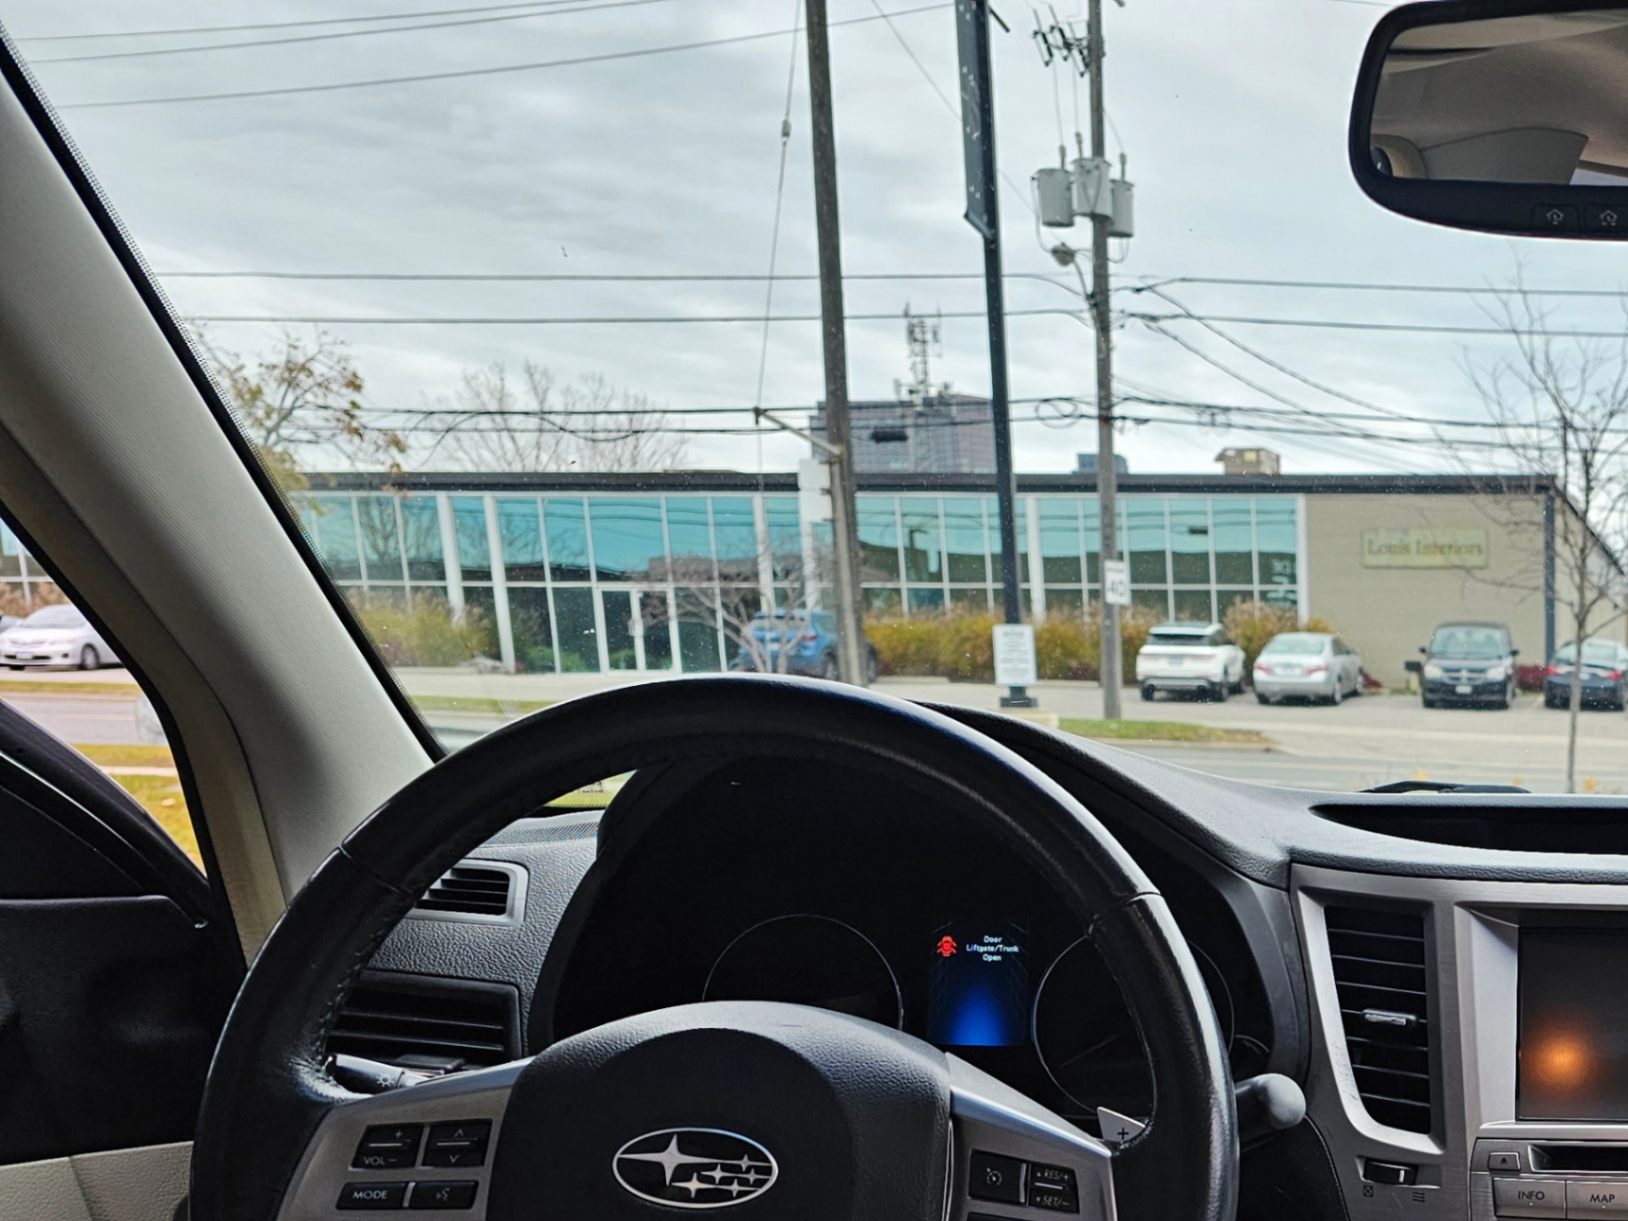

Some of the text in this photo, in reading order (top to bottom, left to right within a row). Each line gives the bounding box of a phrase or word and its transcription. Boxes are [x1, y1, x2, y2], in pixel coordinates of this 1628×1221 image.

[1367, 539, 1482, 555] Louis Interiors
[983, 935, 1002, 943] Door
[966, 944, 1019, 953] Liftgate/Trunk
[982, 953, 1002, 962] Open
[363, 1155, 385, 1165] VOL
[352, 1190, 388, 1200] MODE
[1517, 1190, 1546, 1201] INFO
[1589, 1193, 1616, 1204] MAP
